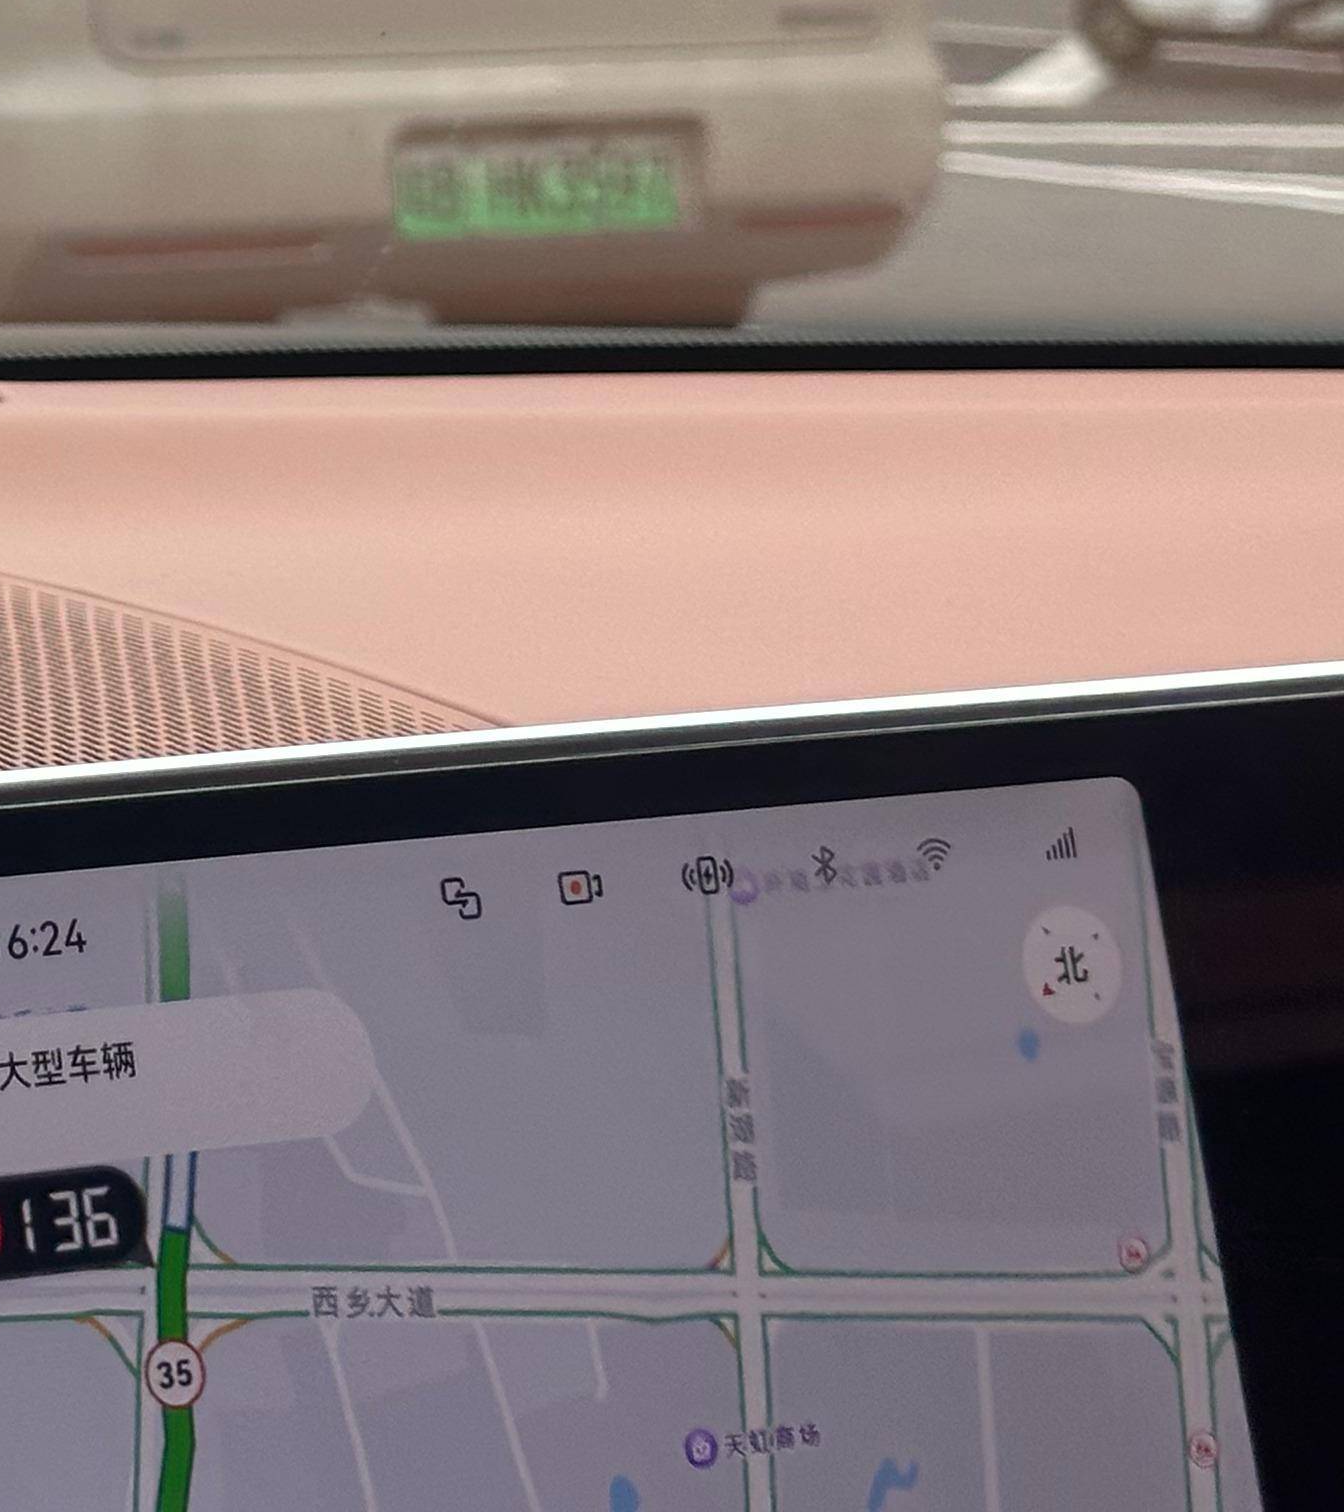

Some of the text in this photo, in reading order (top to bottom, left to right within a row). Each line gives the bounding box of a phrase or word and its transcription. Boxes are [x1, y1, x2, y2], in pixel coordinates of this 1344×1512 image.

[1054, 945, 1089, 985] 北
[21, 1186, 119, 1253] 136
[312, 1285, 436, 1318] 西乡大道
[156, 1358, 194, 1389] 35
